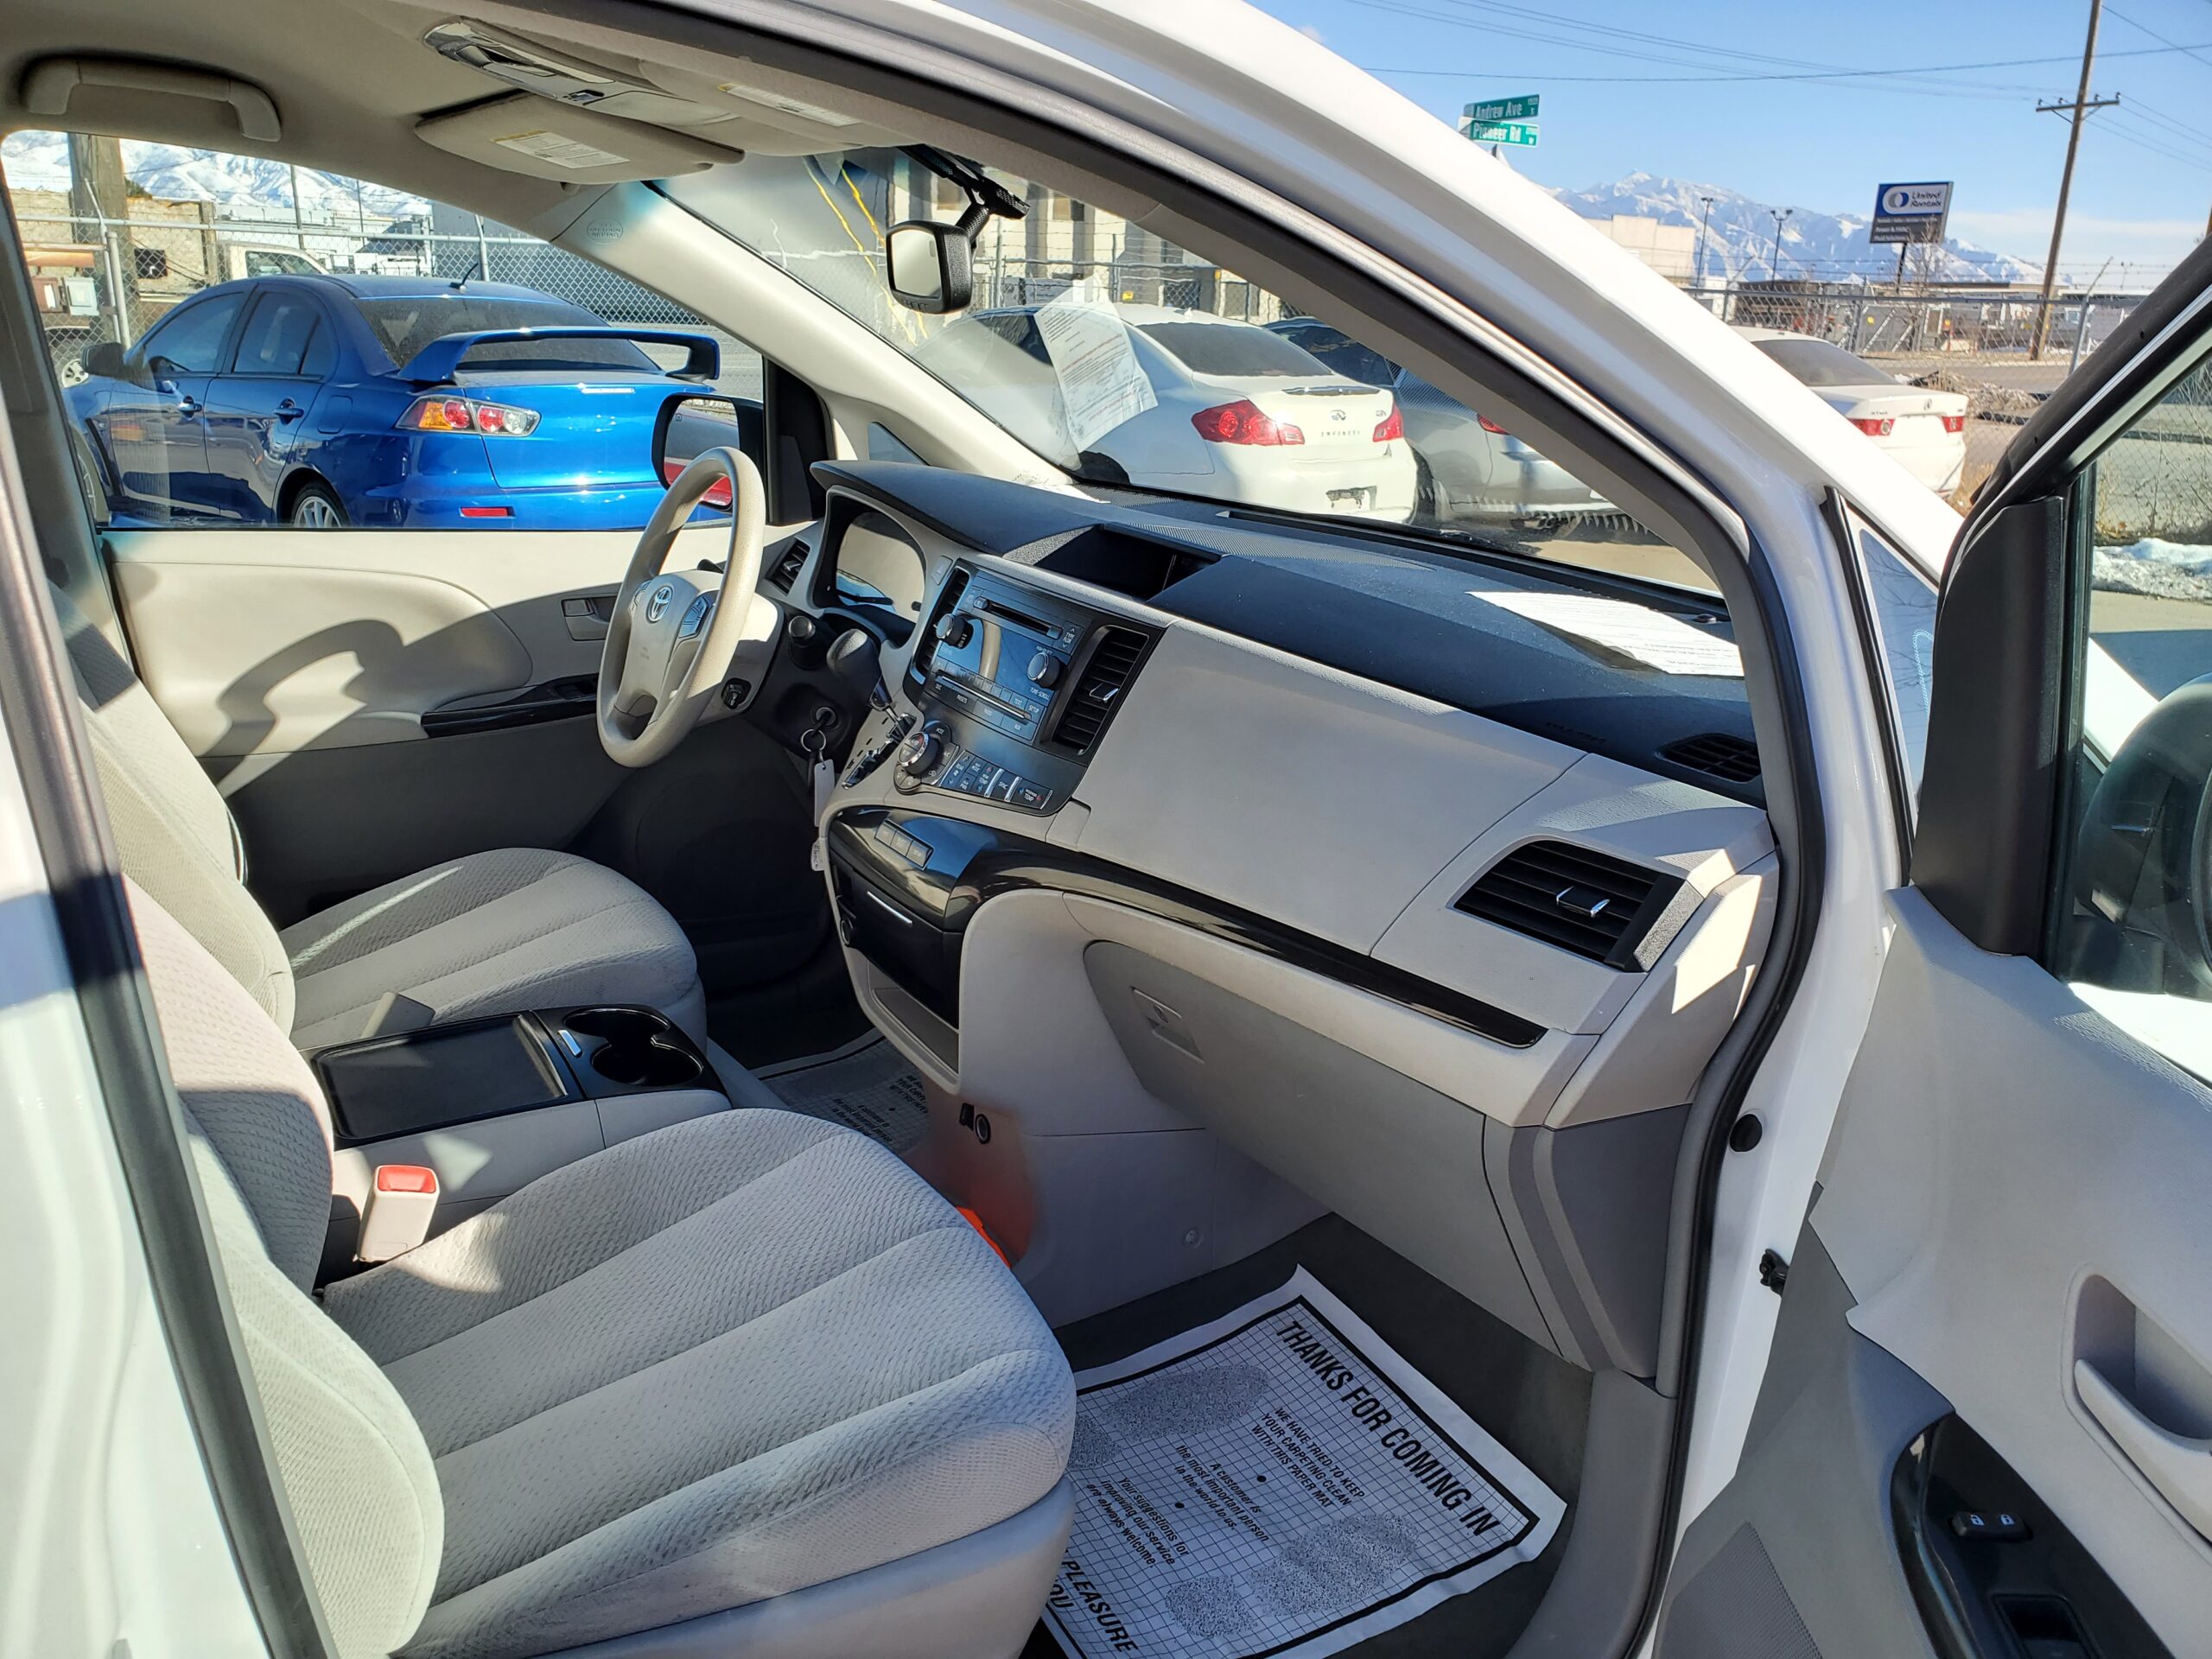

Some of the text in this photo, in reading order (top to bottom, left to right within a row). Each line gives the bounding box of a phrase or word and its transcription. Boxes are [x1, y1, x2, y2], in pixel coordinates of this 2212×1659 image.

[1473, 122, 1508, 141] Pioneer
[1510, 125, 1522, 143] Rd
[1476, 105, 1503, 120] Andrew
[1505, 101, 1522, 117] Ave
[1251, 1424, 1335, 1507] WITH THIS PAPER MAT
[1262, 1413, 1351, 1505] YOUR CARPETING CLEAN
[1275, 1408, 1364, 1497] WE HAVE TRIED TO KEEP
[1276, 1320, 1501, 1536] THANKS FOR COMING IN
[1086, 1484, 1102, 1497] are
[1098, 1499, 1125, 1528] always
[1100, 1480, 1175, 1565] improving our service
[1118, 1477, 1190, 1555] Your suggestions for
[1174, 1465, 1185, 1474] in
[1182, 1474, 1198, 1487] the
[1195, 1488, 1220, 1509] world
[1224, 1518, 1237, 1530] us.
[1176, 1446, 1269, 1541] the most important person
[1217, 1471, 1254, 1503] customer
[1050, 1580, 1074, 1608] OU
[1061, 1560, 1139, 1652] PLEASURE
